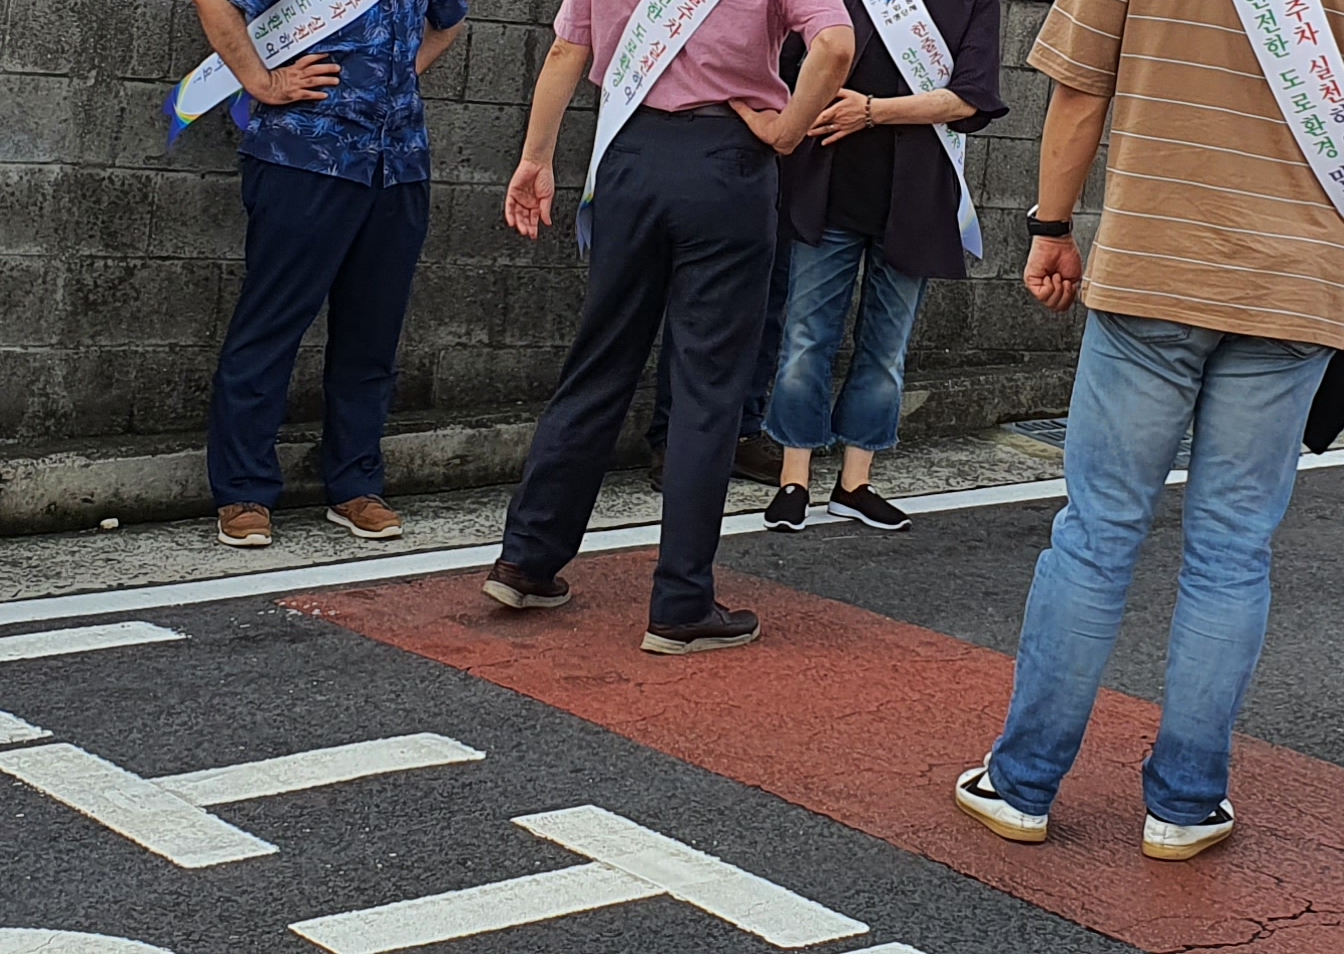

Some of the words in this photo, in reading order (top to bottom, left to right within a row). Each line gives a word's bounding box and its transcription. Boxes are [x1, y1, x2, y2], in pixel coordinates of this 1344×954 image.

[265, 14, 326, 60] 실천하여
[909, 20, 951, 82] 한줄주차
[624, 40, 667, 106] 실천하여
[1279, 68, 1339, 159] 도로환경
